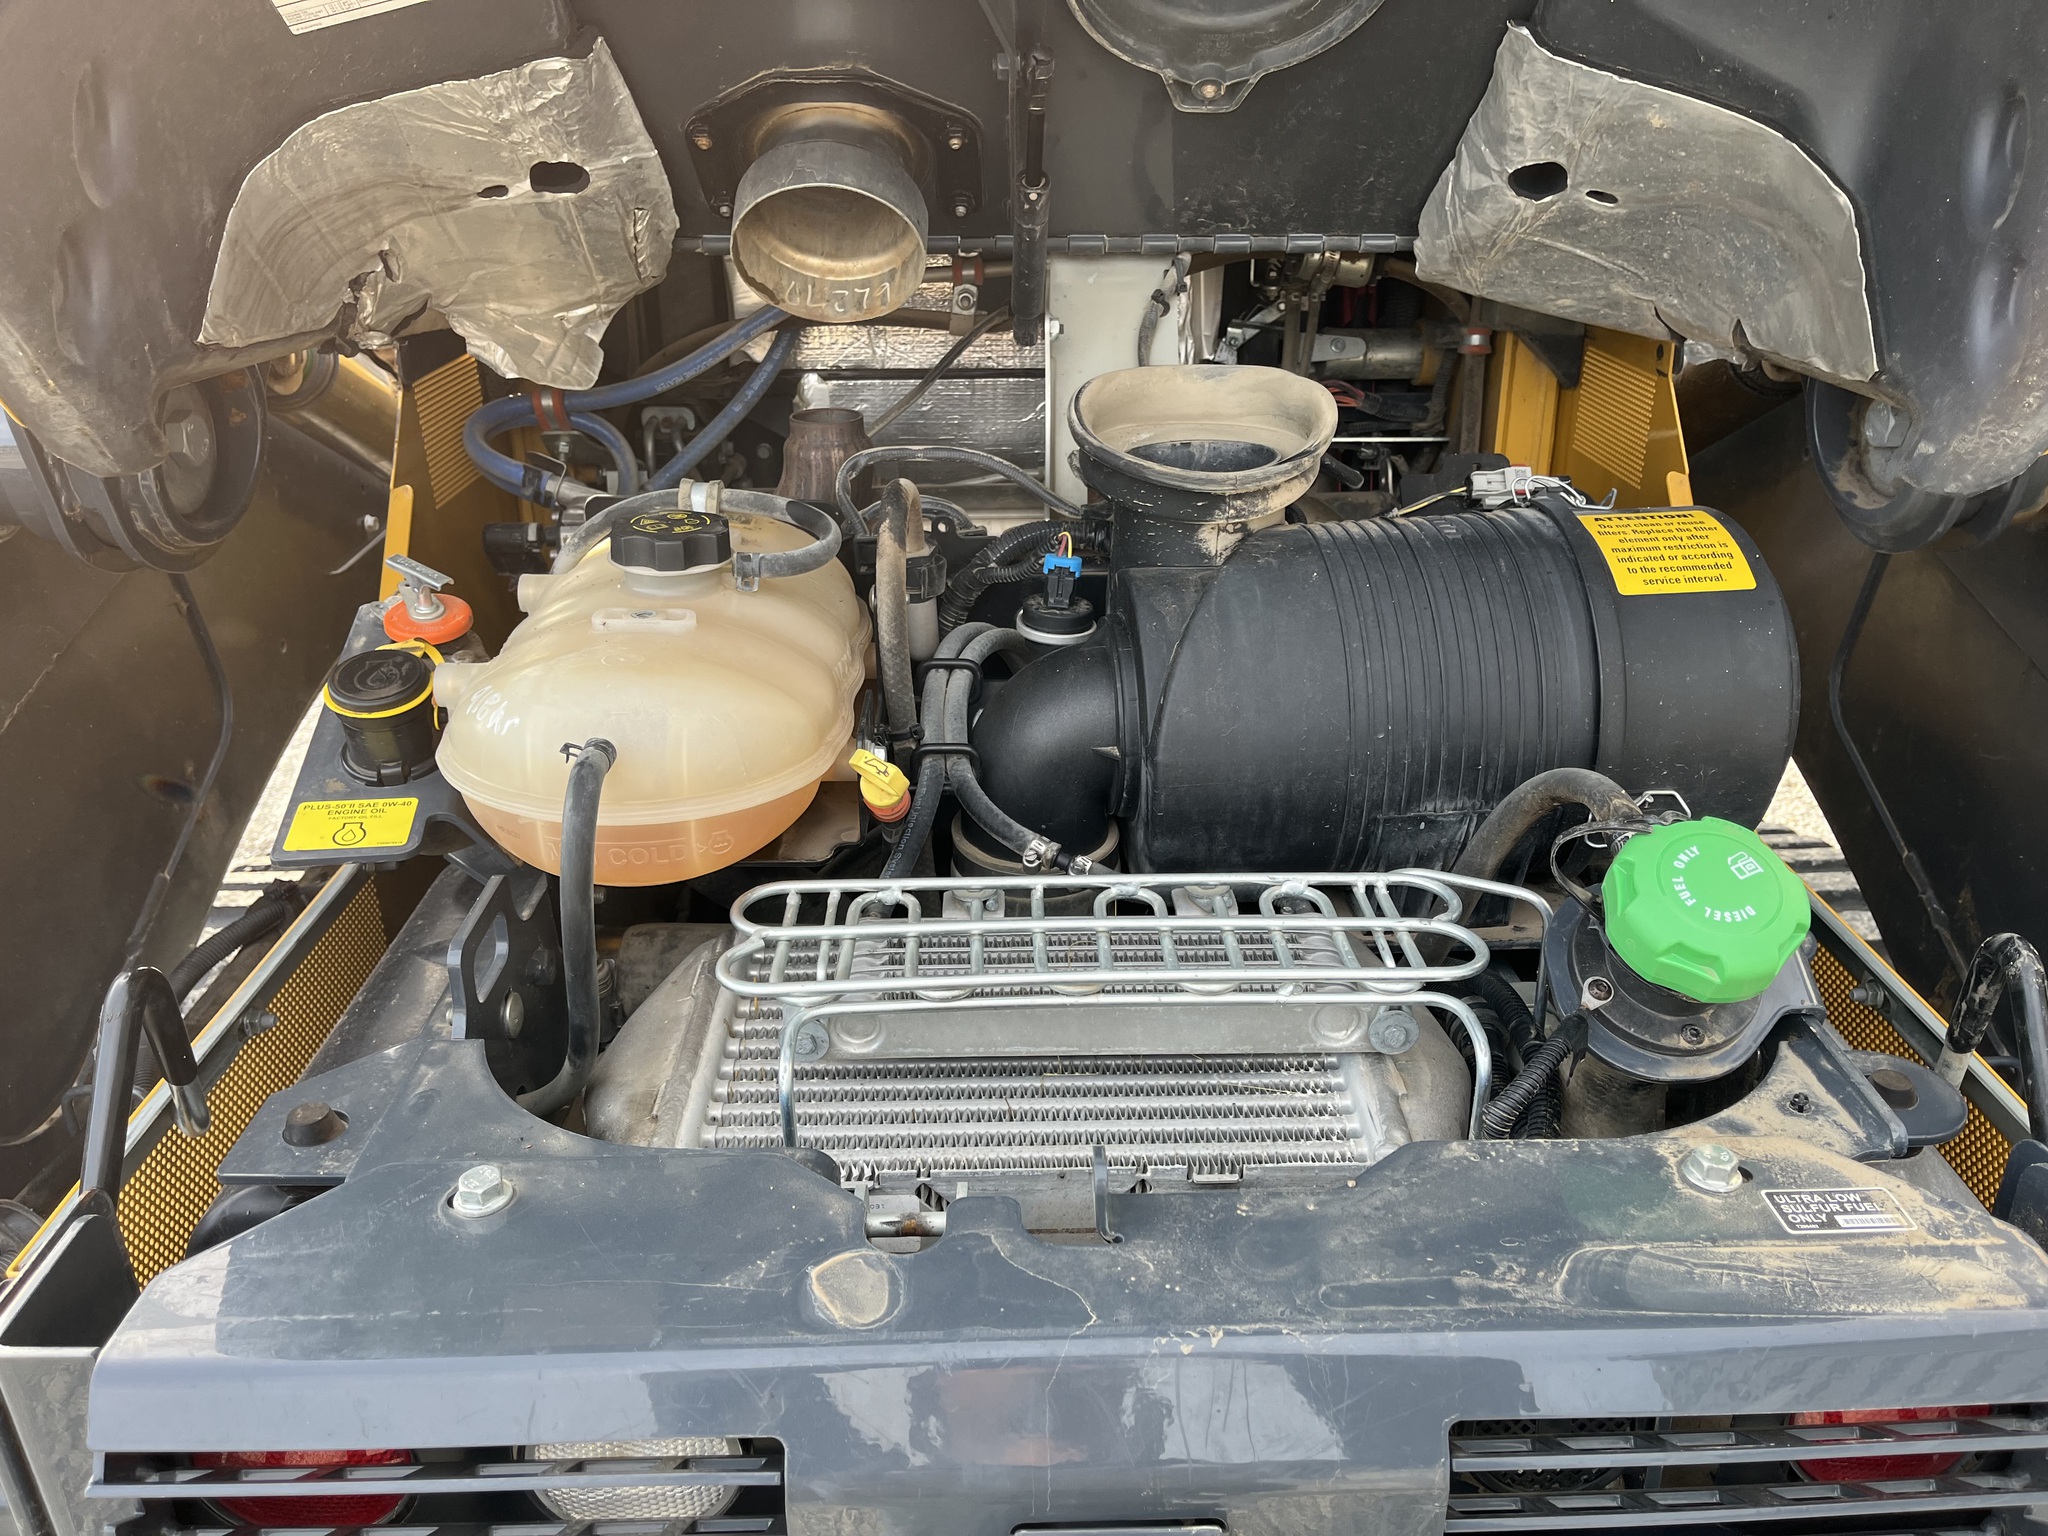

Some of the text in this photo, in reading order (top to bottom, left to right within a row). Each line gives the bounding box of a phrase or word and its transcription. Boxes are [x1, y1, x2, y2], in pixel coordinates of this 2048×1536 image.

[1593, 513, 1695, 522] ATTENTION!
[1597, 529, 1631, 537] filters.
[1632, 527, 1674, 537] Replace
[1692, 525, 1719, 533] filter
[1618, 533, 1710, 544] element only after
[1611, 540, 1729, 554] maximum restriction is
[1616, 551, 1734, 564] indicated or according
[1627, 561, 1733, 575] to the recommended
[1642, 573, 1727, 586] service interval.
[357, 801, 379, 809] SAE
[327, 808, 368, 816] ENGINE
[607, 844, 687, 866] COLD
[1671, 845, 1757, 923] DIESEL FUEL ONLY
[1773, 1192, 1862, 1204] ULTRA LOW
[1780, 1202, 1886, 1214] SULFUR FUEL
[1787, 1213, 1828, 1224] ONLY
